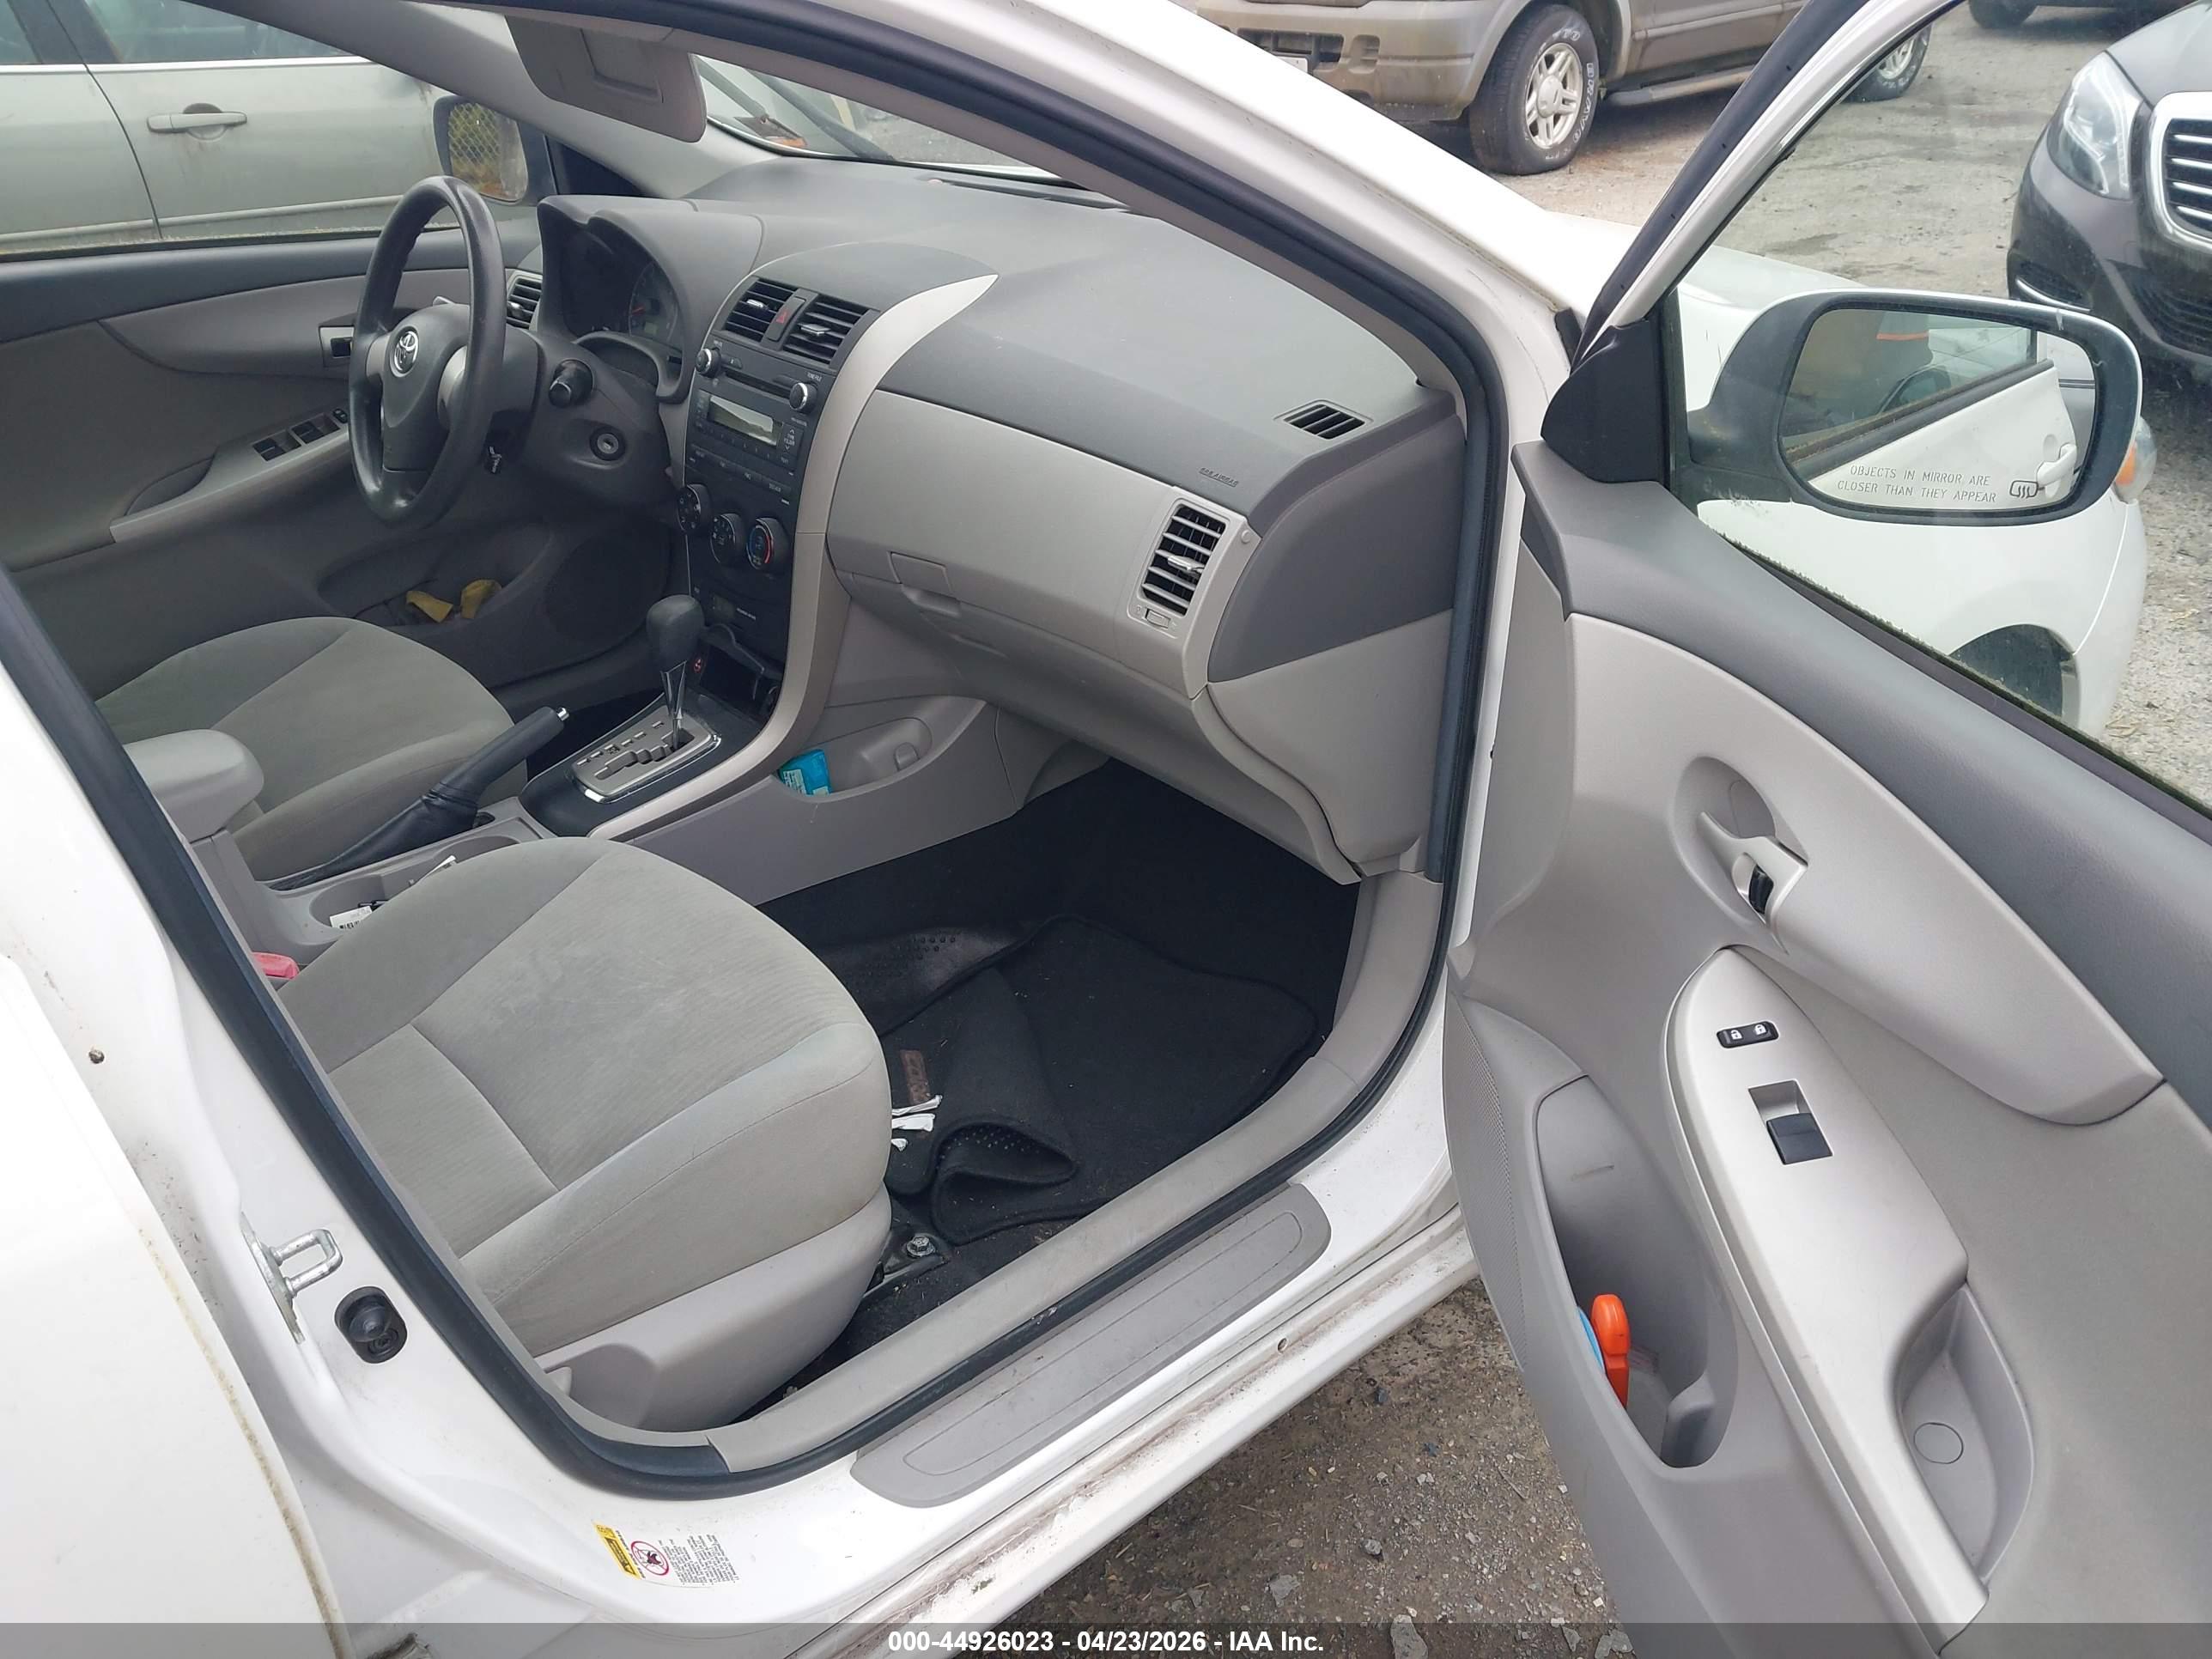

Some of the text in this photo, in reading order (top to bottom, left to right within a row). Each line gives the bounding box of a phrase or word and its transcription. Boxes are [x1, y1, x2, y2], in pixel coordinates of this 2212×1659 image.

[1850, 465, 1991, 486] OBJECTS IN MIRROR ARE
[1838, 480, 1997, 502] CLOSER THAN THEY APPEAR
